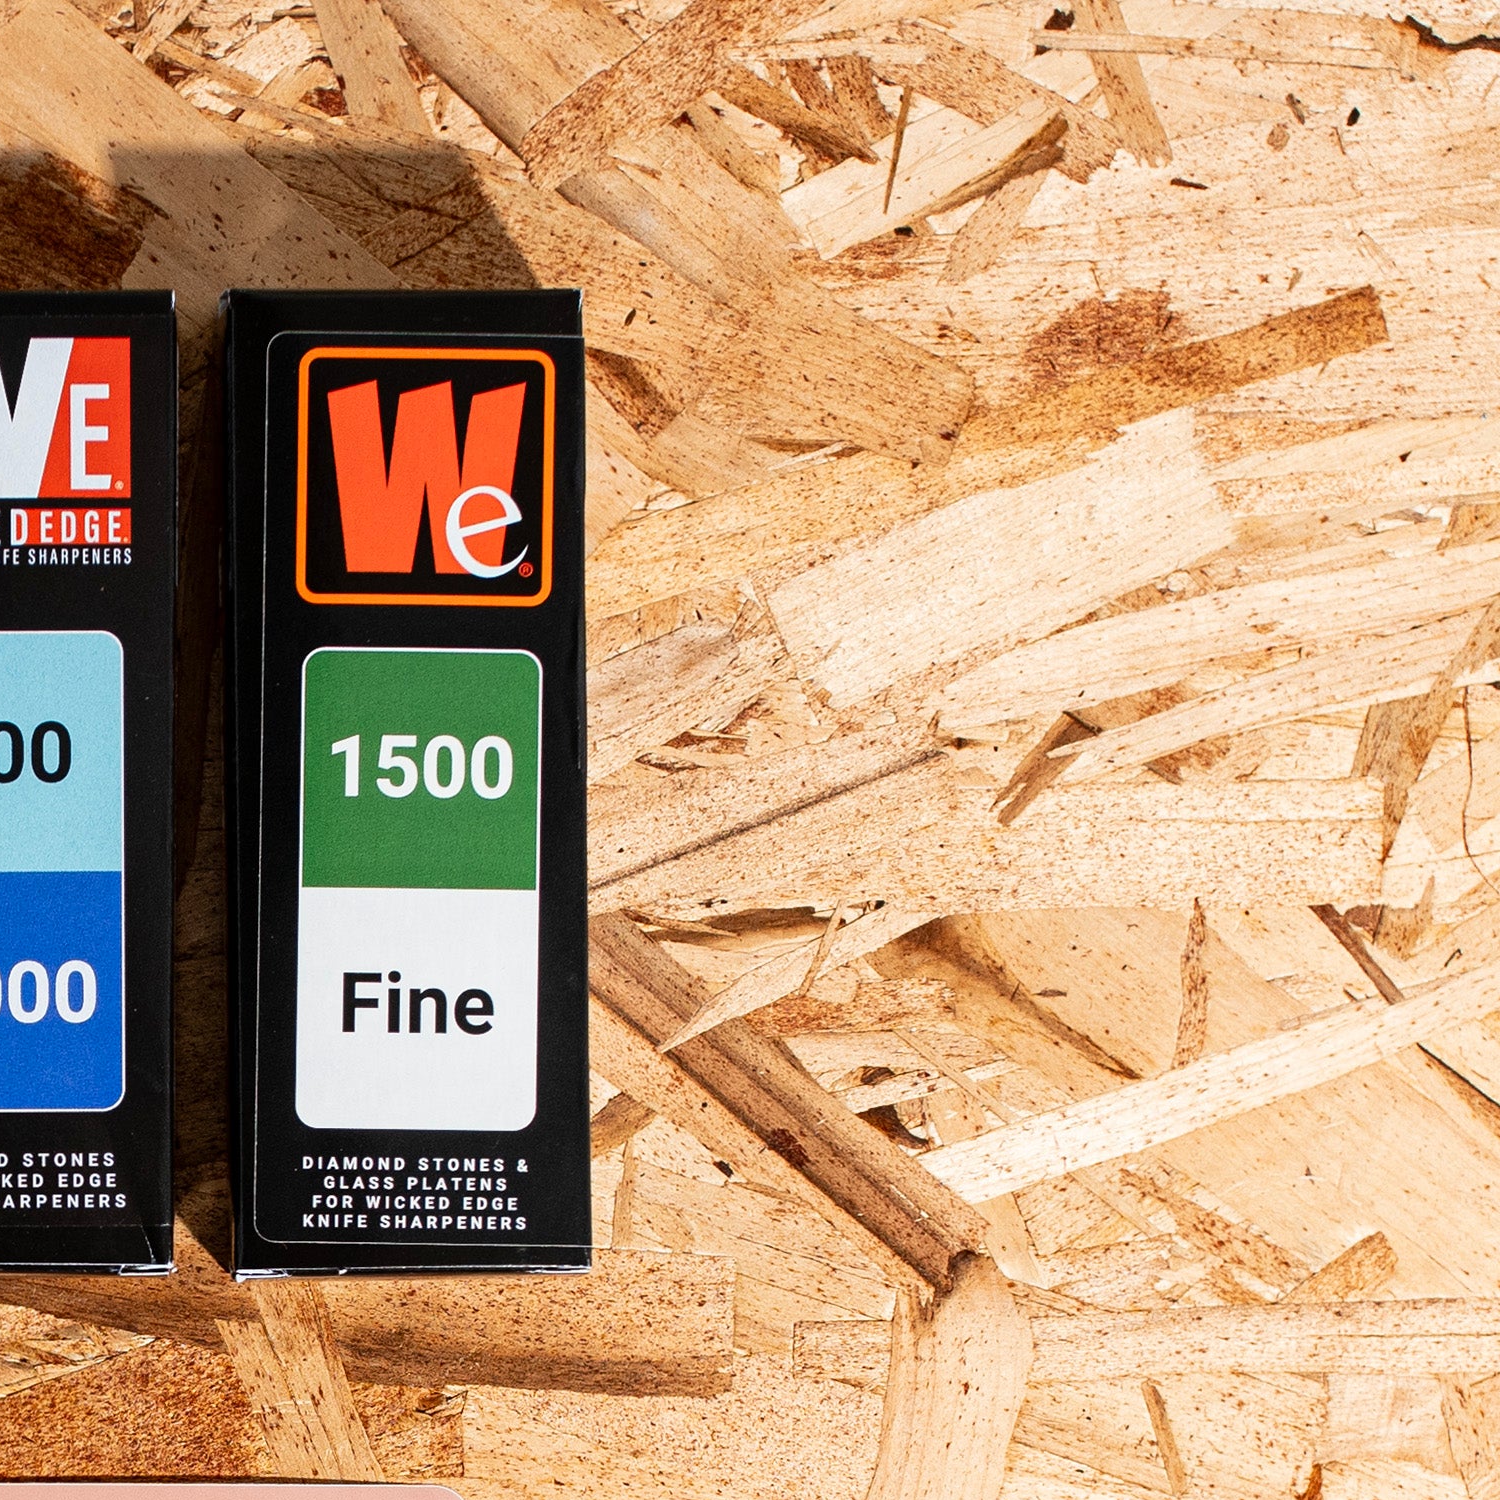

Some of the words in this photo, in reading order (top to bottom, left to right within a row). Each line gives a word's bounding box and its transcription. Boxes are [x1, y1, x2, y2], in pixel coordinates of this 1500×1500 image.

[28, 548, 131, 564] SHARPENERS
[332, 735, 513, 799] 1500
[343, 971, 493, 1034] Fine
[23, 1153, 114, 1167] STONES
[303, 1156, 405, 1170] DIAMOND
[418, 1158, 504, 1172] STONES
[517, 1159, 528, 1172] &
[58, 1173, 116, 1187] EDGE
[324, 1176, 394, 1190] GLASS
[407, 1177, 506, 1191] PLATENS
[313, 1195, 352, 1208] FOR
[366, 1196, 449, 1209] WICKED
[463, 1197, 517, 1210] EDGE
[303, 1214, 367, 1228] KNIFE
[380, 1215, 526, 1230] SHARPENERS
